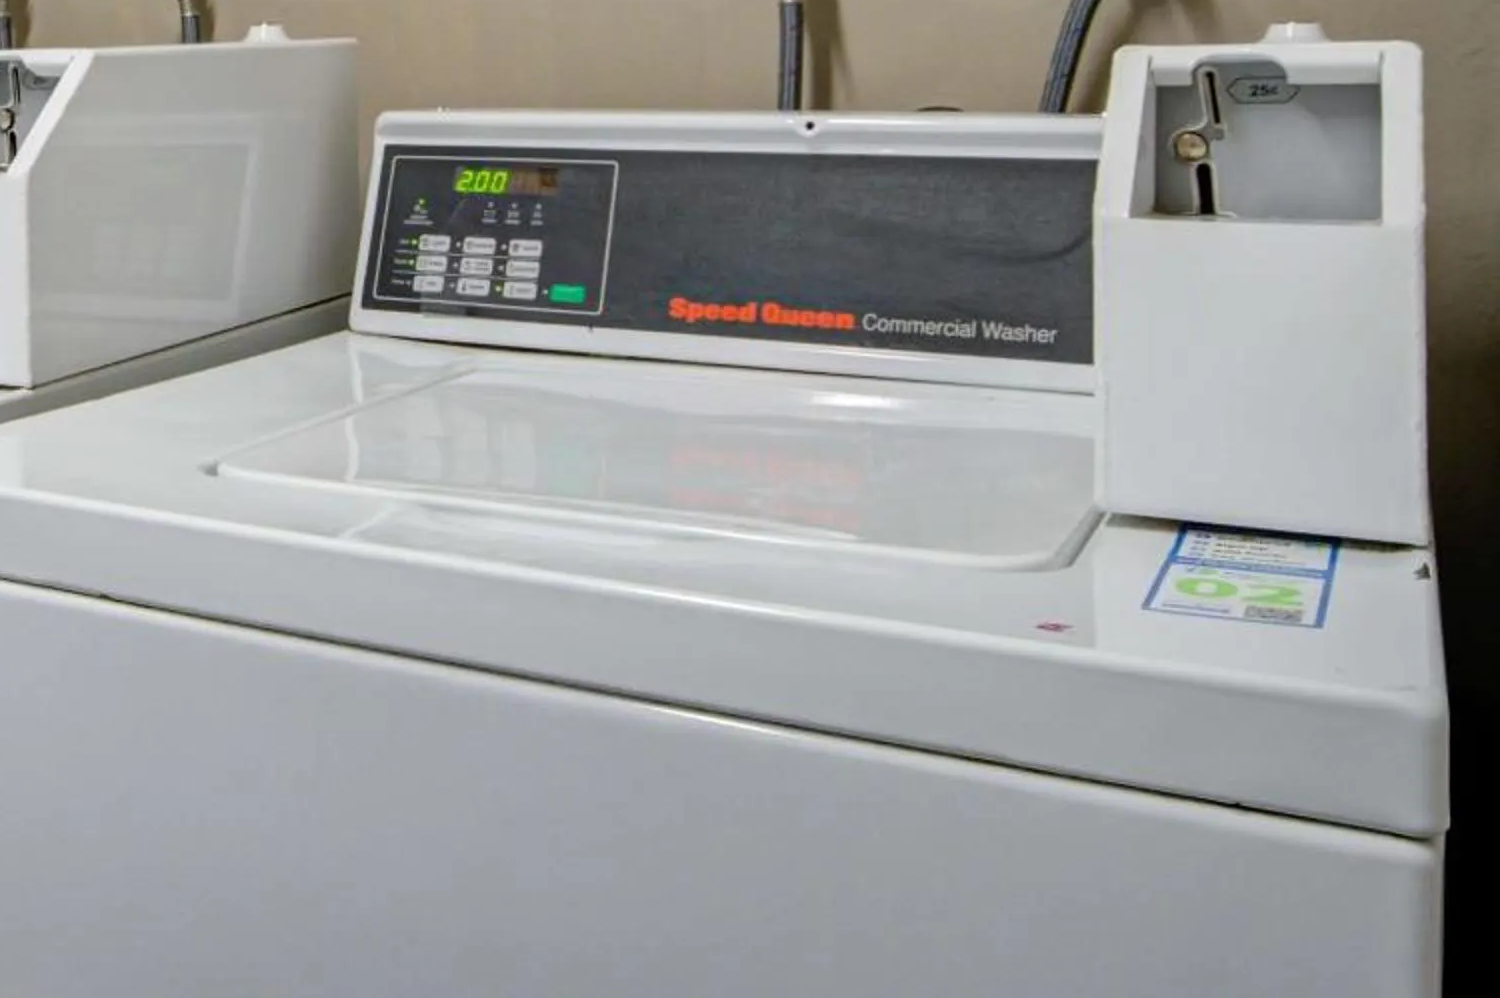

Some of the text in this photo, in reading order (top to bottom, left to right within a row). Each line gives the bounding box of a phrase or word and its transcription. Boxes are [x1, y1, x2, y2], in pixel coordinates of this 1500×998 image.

[668, 297, 1059, 344] Speed Queen Commercial Washer
